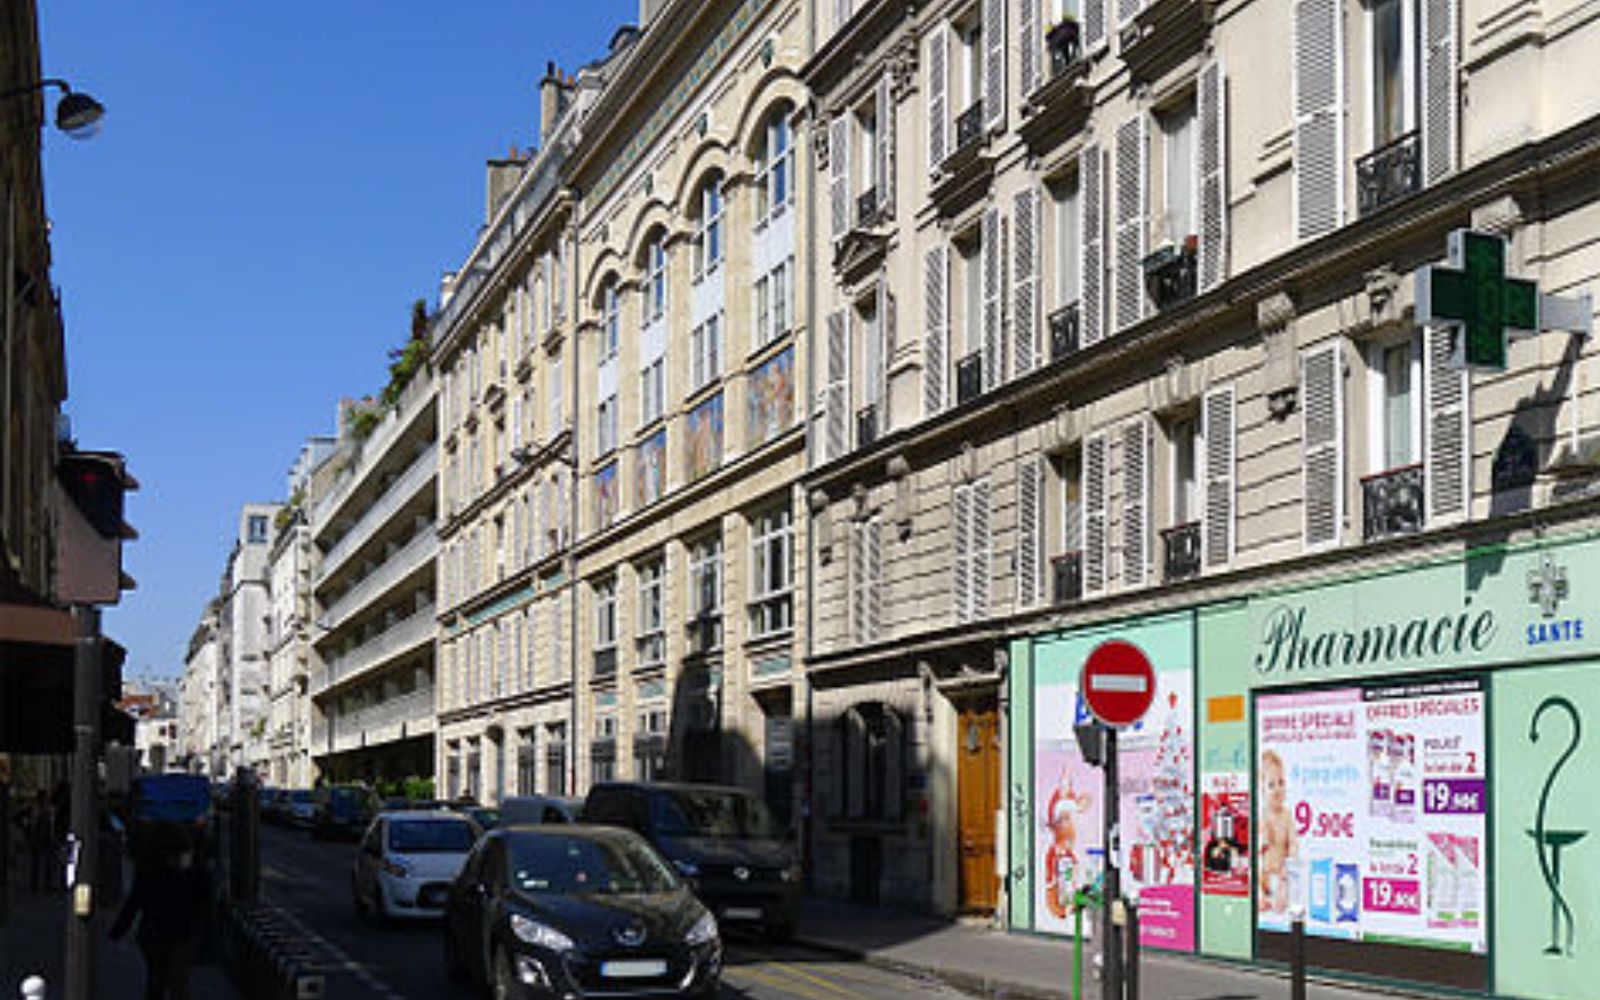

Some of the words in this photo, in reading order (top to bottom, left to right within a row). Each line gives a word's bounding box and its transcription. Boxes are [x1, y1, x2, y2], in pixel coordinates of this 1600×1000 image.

[1255, 596, 1497, 673] Pharmacie
[1465, 751, 1477, 773] 2
[1295, 801, 1354, 838] 9.90€
[1408, 853, 1419, 875] 2
